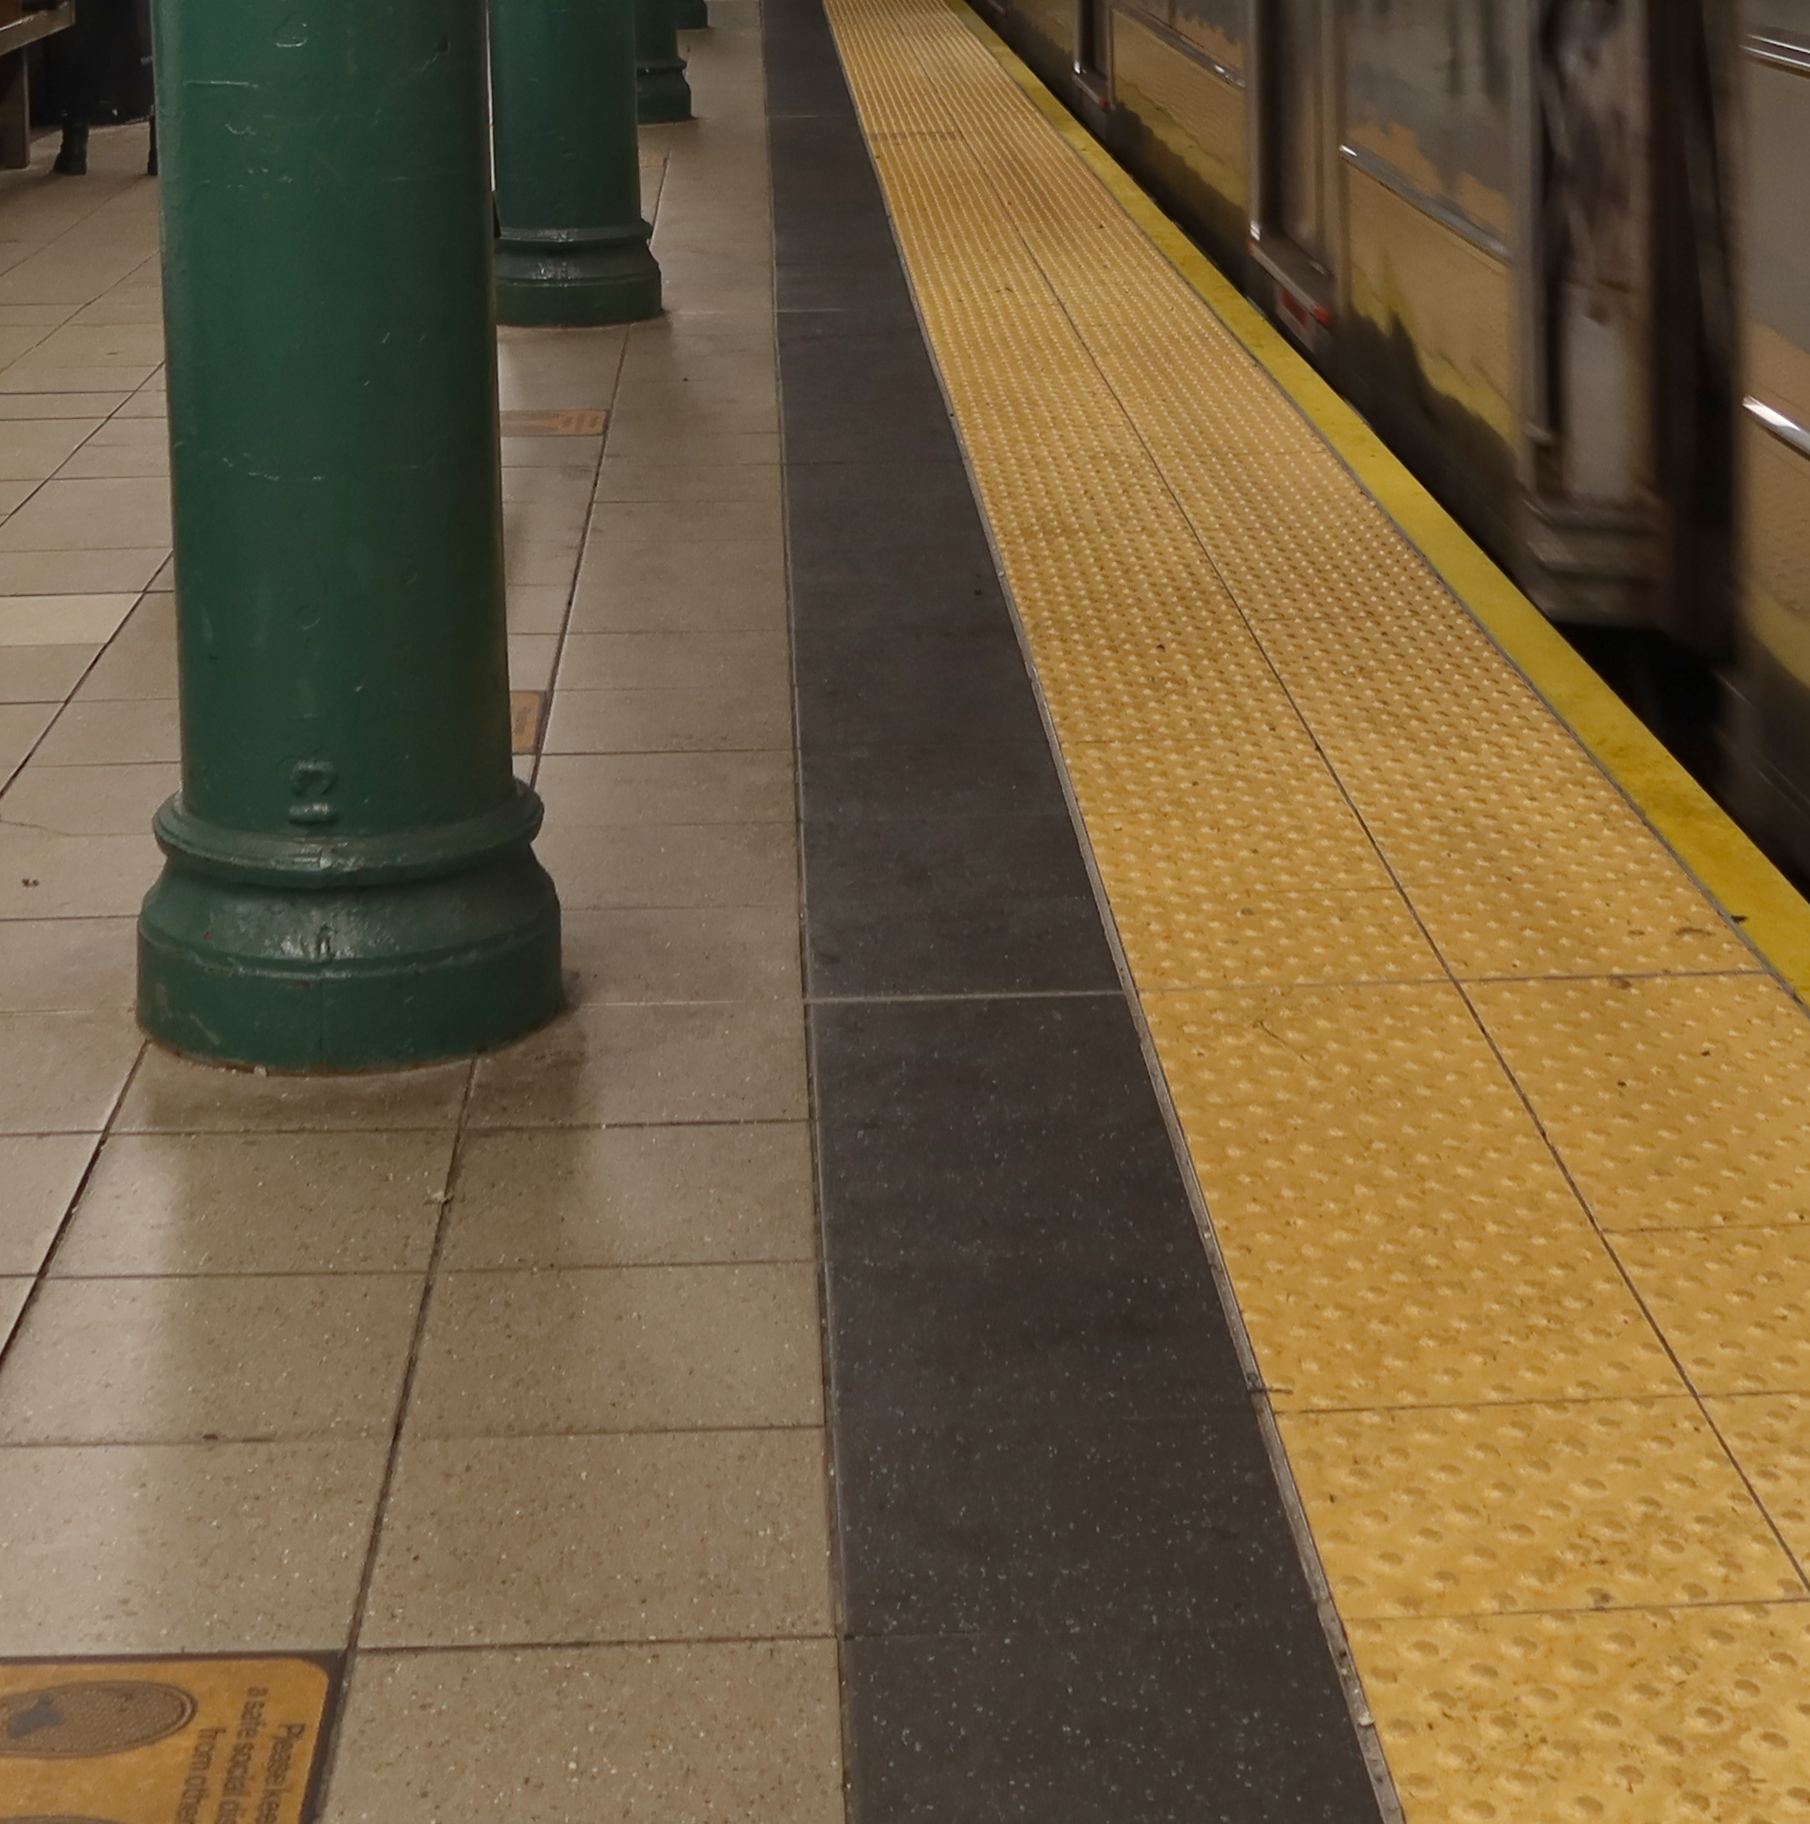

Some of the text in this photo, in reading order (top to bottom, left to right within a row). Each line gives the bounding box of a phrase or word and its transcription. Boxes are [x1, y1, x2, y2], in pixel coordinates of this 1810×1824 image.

[236, 1700, 267, 1739] safe
[221, 1741, 257, 1797] social
[264, 1723, 307, 1787] Please
